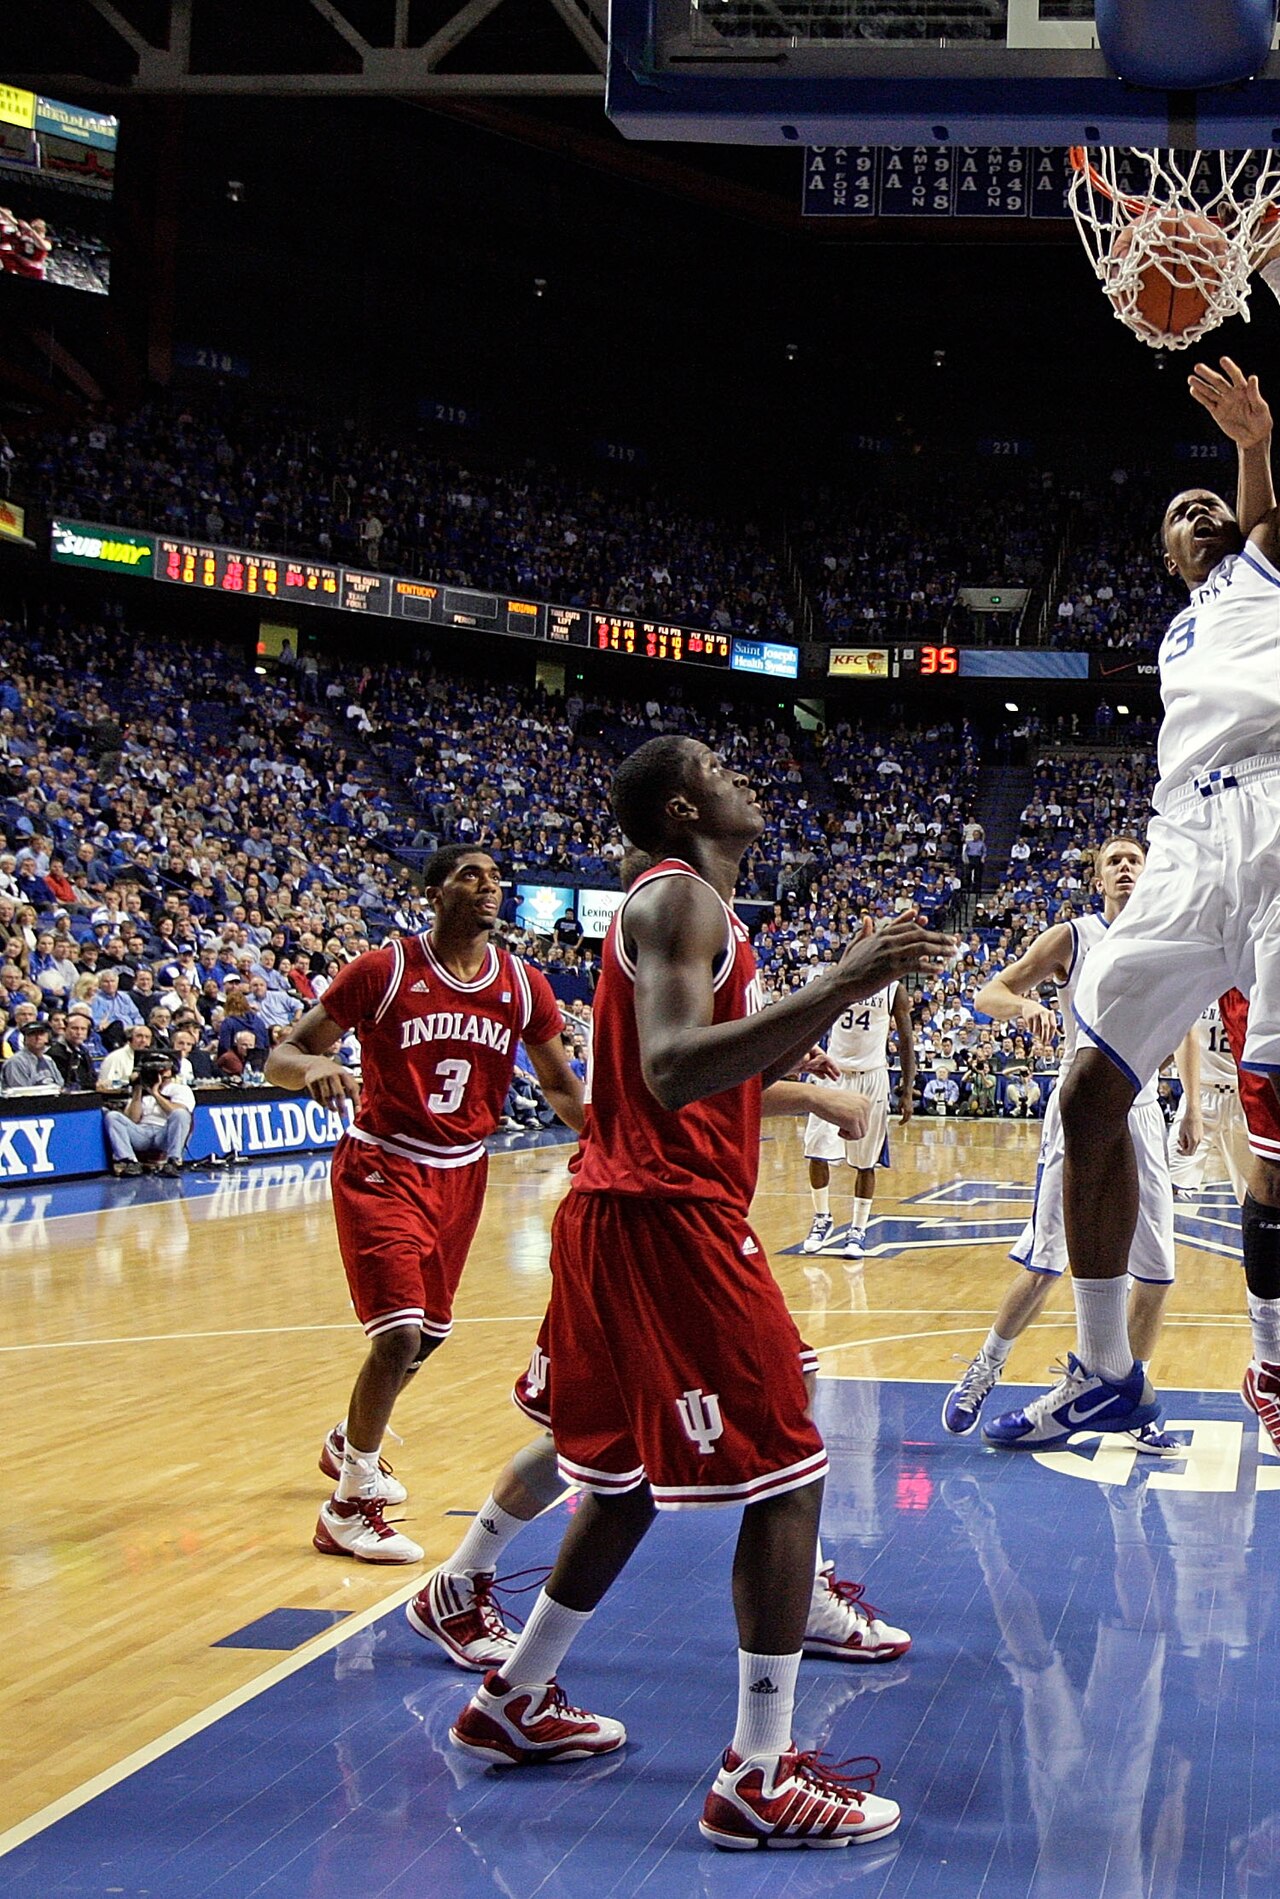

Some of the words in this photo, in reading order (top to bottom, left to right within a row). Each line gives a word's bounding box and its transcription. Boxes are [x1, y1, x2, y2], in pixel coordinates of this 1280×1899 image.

[436, 405, 467, 424] 219
[992, 442, 1020, 456] 221
[1190, 444, 1219, 458] 223
[57, 535, 151, 565] SUBWAY
[183, 569, 194, 583] 0
[204, 573, 214, 586] 0
[222, 575, 242, 590] 20
[308, 576, 317, 590] 2
[397, 583, 438, 599] KENTUCKY
[610, 640, 618, 650] 4
[659, 636, 666, 645] 4
[672, 637, 682, 648] 10
[1166, 617, 1196, 663] 3
[674, 649, 681, 660] 5
[706, 642, 712, 654] 0
[720, 644, 727, 656] 0
[735, 642, 760, 656] Saint
[761, 646, 796, 664] Joseph
[734, 655, 764, 670] Health
[764, 660, 795, 674] System
[834, 655, 864, 665] KFC
[921, 646, 958, 674] 35
[1136, 665, 1158, 674] ver
[841, 1009, 870, 1031] 34
[400, 1012, 512, 1056] INDIANA
[1208, 1026, 1232, 1053] 12
[427, 1058, 472, 1114] 3
[210, 1097, 354, 1154] WILDCA
